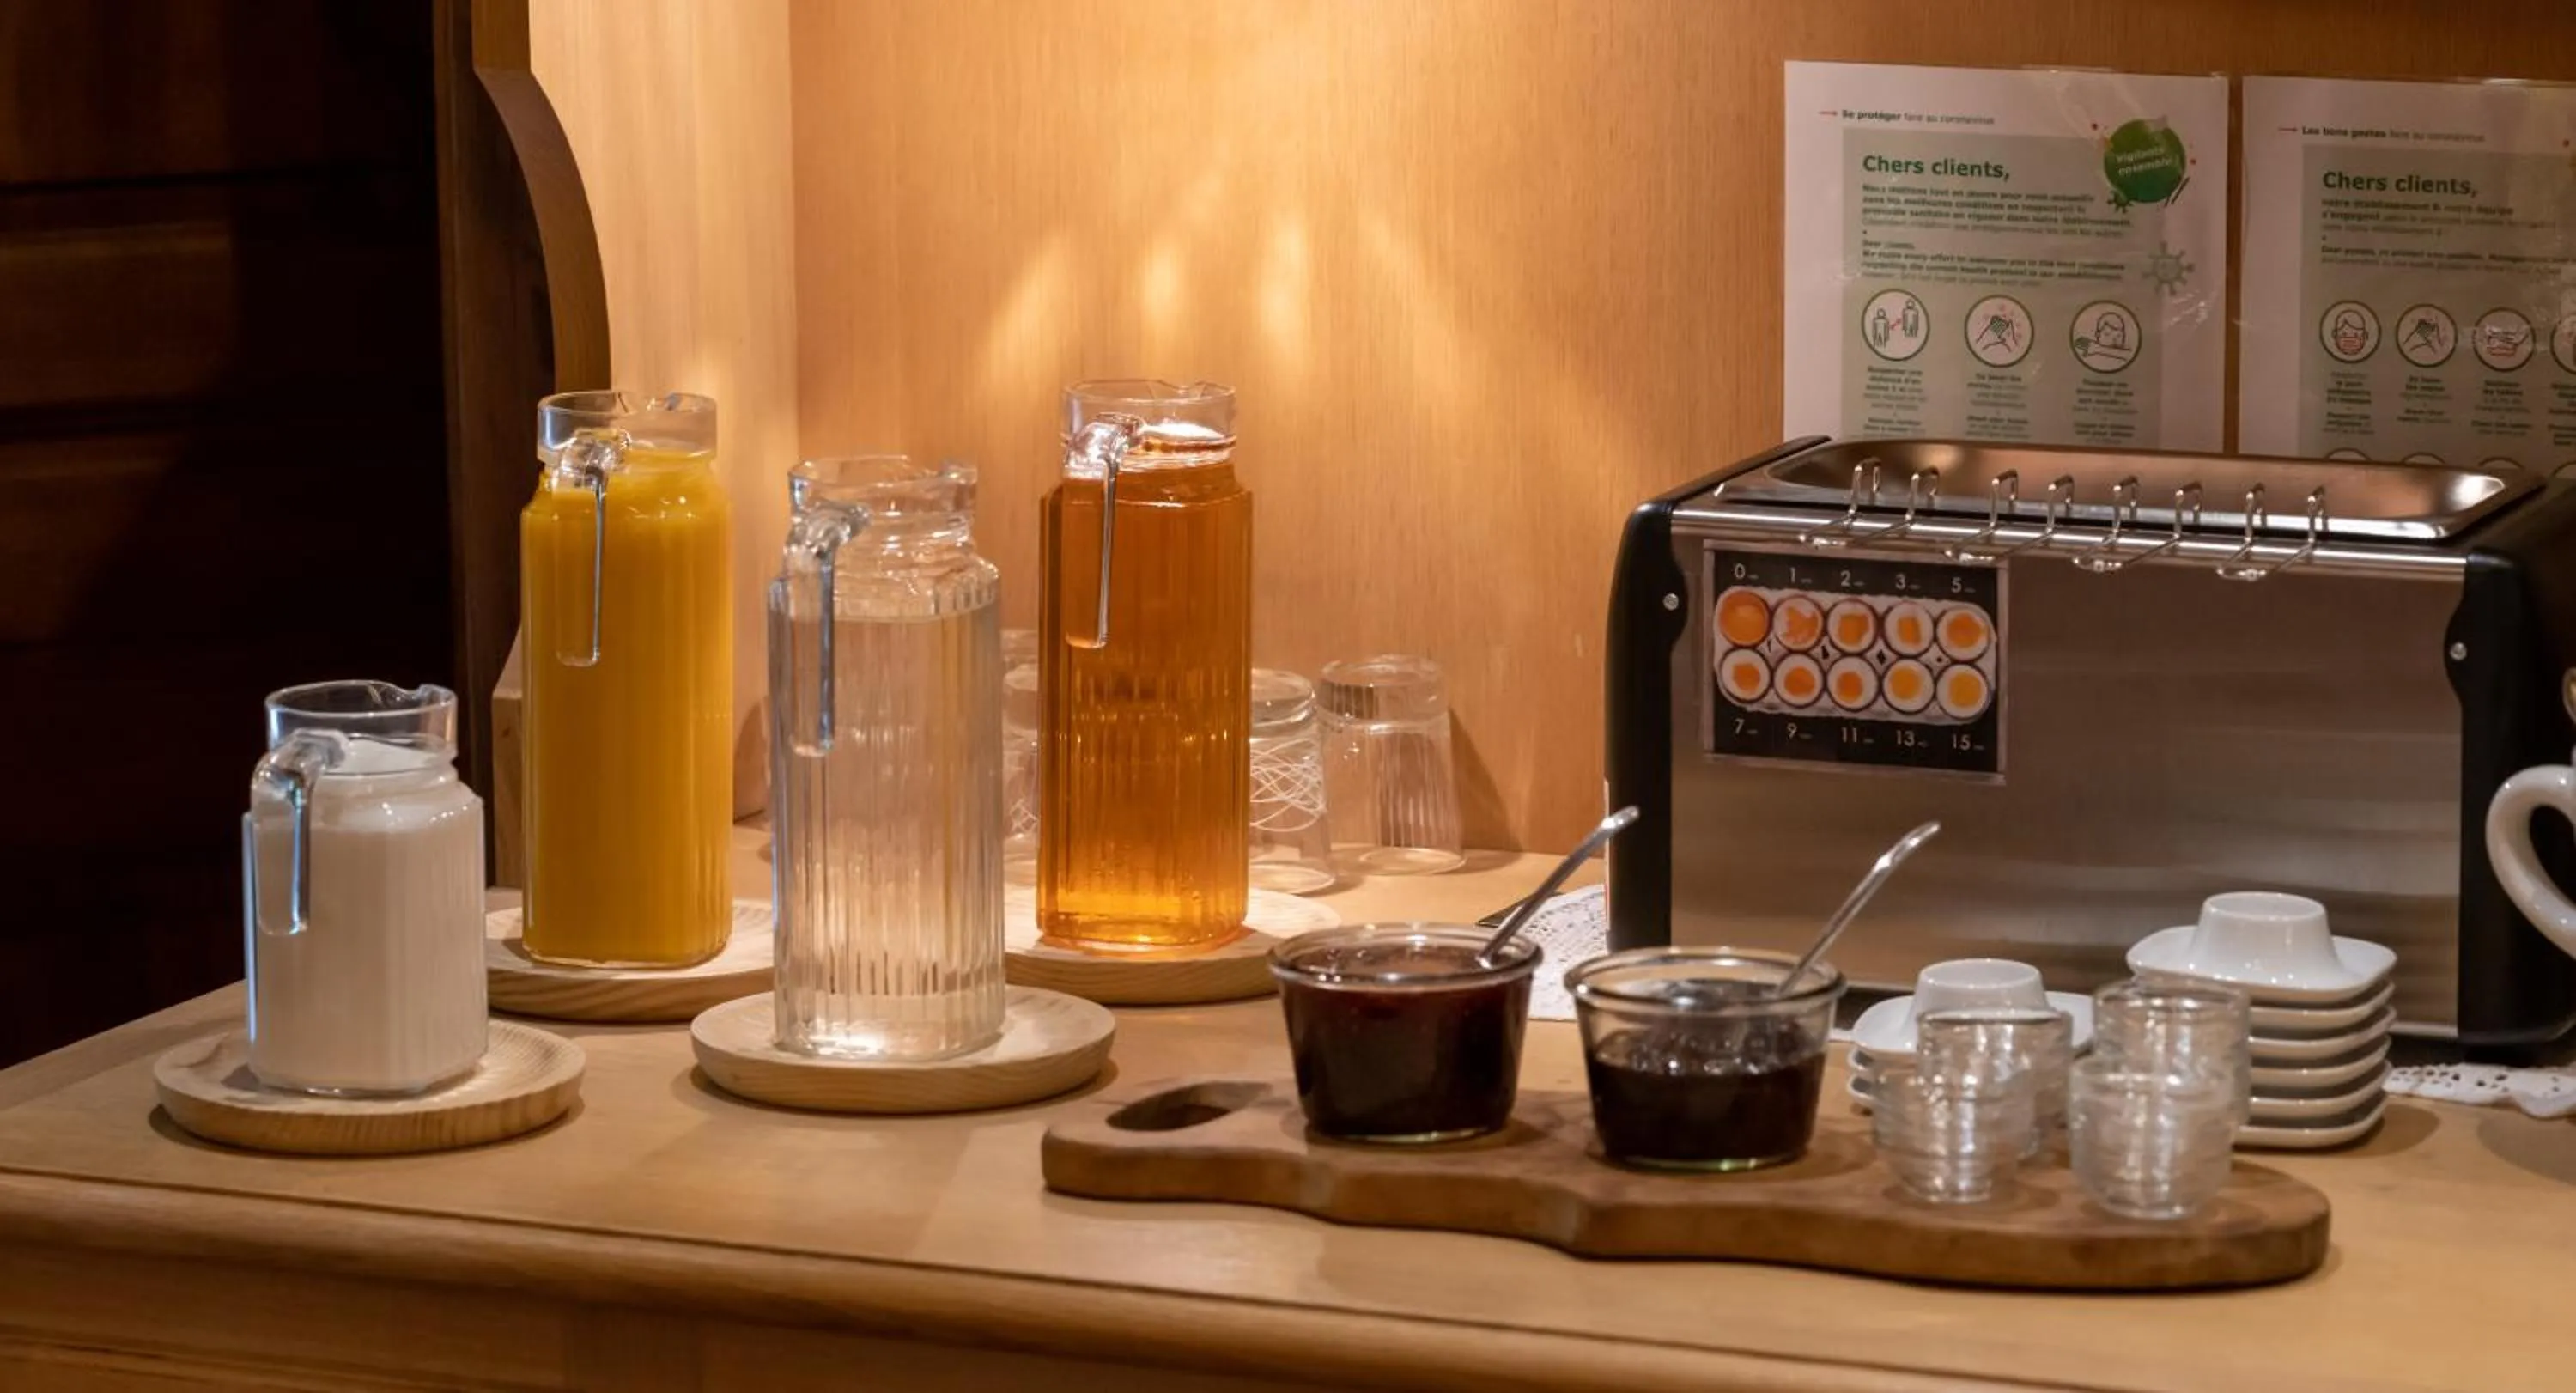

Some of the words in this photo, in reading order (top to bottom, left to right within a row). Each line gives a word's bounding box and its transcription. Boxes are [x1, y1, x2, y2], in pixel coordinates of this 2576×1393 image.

[1862, 155, 1924, 174] Chers
[1931, 158, 2010, 181] clients,
[2322, 171, 2388, 192] Chers
[2395, 174, 2478, 198] clients,
[1734, 563, 1746, 580] 0
[1840, 570, 1851, 587] 2
[1895, 574, 1907, 590] 3
[1951, 577, 1962, 594] 5
[1735, 718, 1745, 735] 7
[1787, 722, 1798, 740] 9
[1841, 726, 1859, 744] 11
[1896, 729, 1915, 747] 13
[1952, 733, 1971, 751] 15
